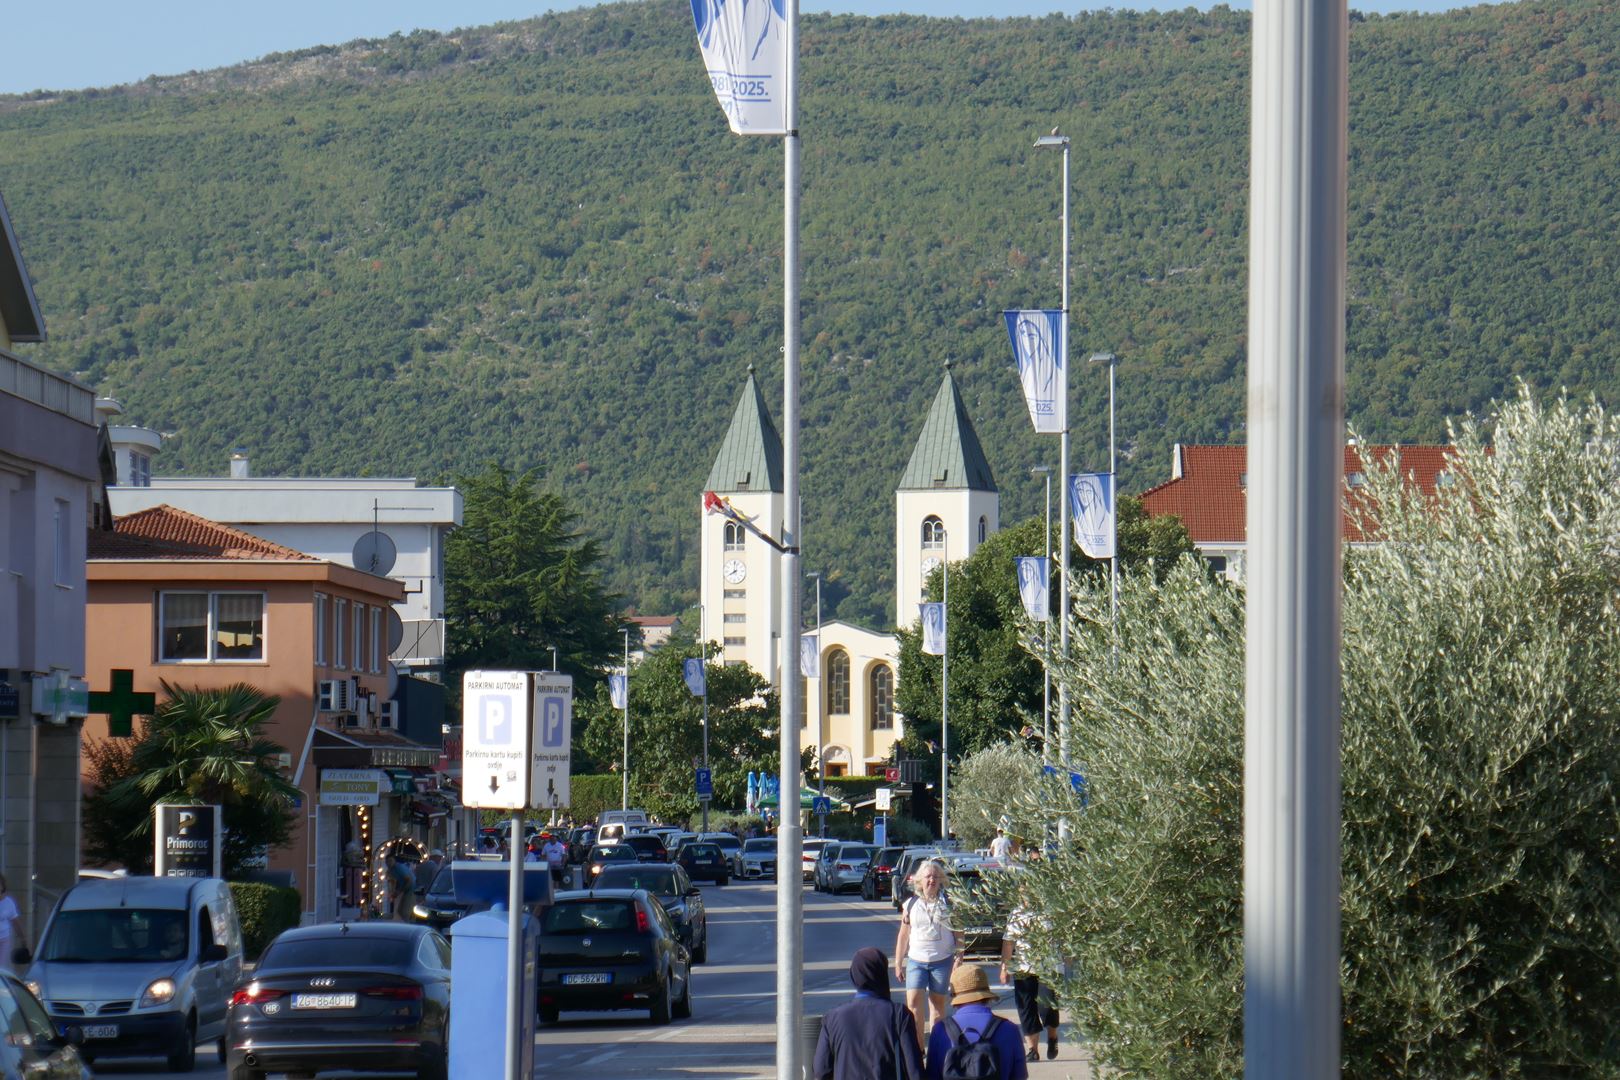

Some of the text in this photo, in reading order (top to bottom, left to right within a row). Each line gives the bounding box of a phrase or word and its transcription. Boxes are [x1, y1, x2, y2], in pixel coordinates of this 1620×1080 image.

[467, 681, 524, 691] PARKIRNI AUTOMAT
[485, 700, 505, 740] P
[547, 702, 560, 742] P
[465, 749, 524, 760] Parkirnu kartu kupiti
[487, 761, 503, 771] ovdje
[700, 772, 707, 783] P
[346, 783, 370, 792] TONY
[166, 836, 208, 849] Primorac
